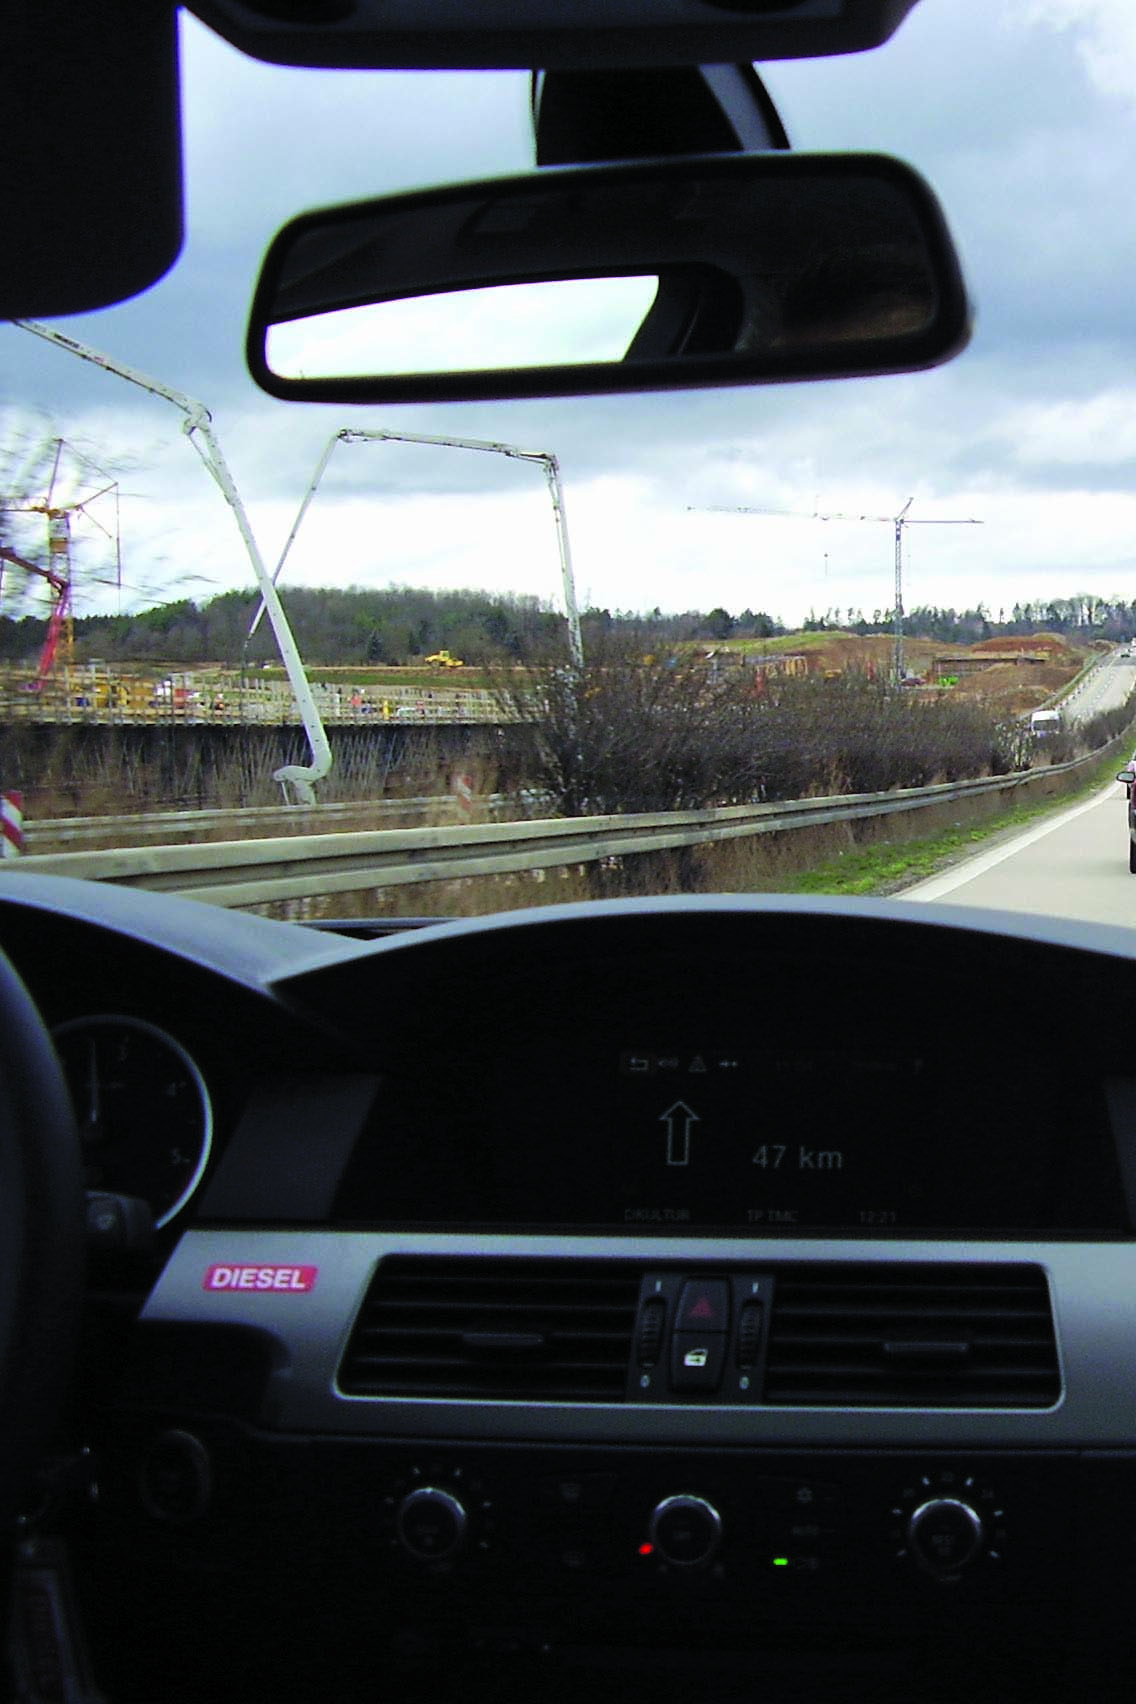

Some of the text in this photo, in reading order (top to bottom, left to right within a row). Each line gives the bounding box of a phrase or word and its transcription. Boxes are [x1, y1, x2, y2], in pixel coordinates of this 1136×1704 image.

[752, 1144, 843, 1169] 47 km
[210, 1267, 305, 1289] DIESEL
